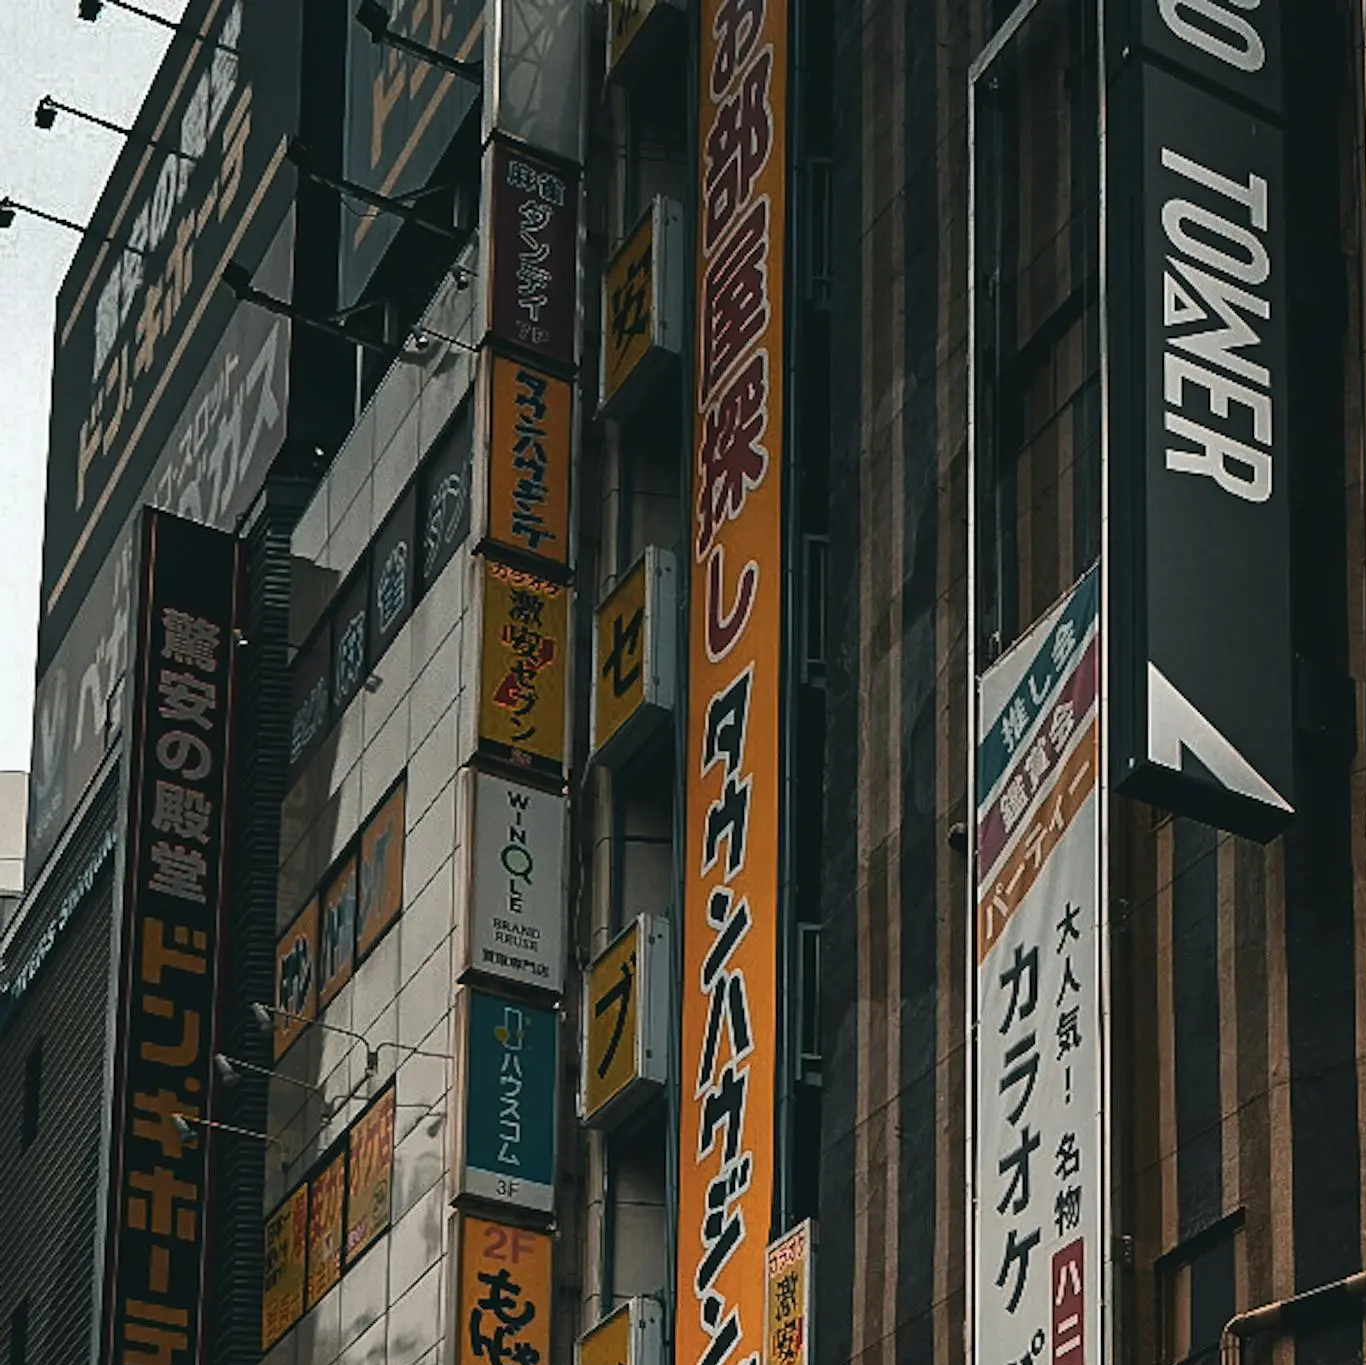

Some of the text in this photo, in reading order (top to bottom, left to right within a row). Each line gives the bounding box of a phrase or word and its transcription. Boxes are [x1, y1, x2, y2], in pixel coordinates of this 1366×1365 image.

[1161, 147, 1273, 503] TOWER
[1001, 619, 1077, 753] 推し会
[148, 607, 220, 905] 驚安の殿堂
[985, 759, 1091, 940] パーティー
[492, 917, 541, 941] BRAND
[494, 931, 540, 953] REUSE
[497, 1056, 521, 1167] ハウスコム
[496, 1179, 519, 1198] 3F
[1054, 1131, 1081, 1239] 名物
[483, 1226, 536, 1263] 2F
